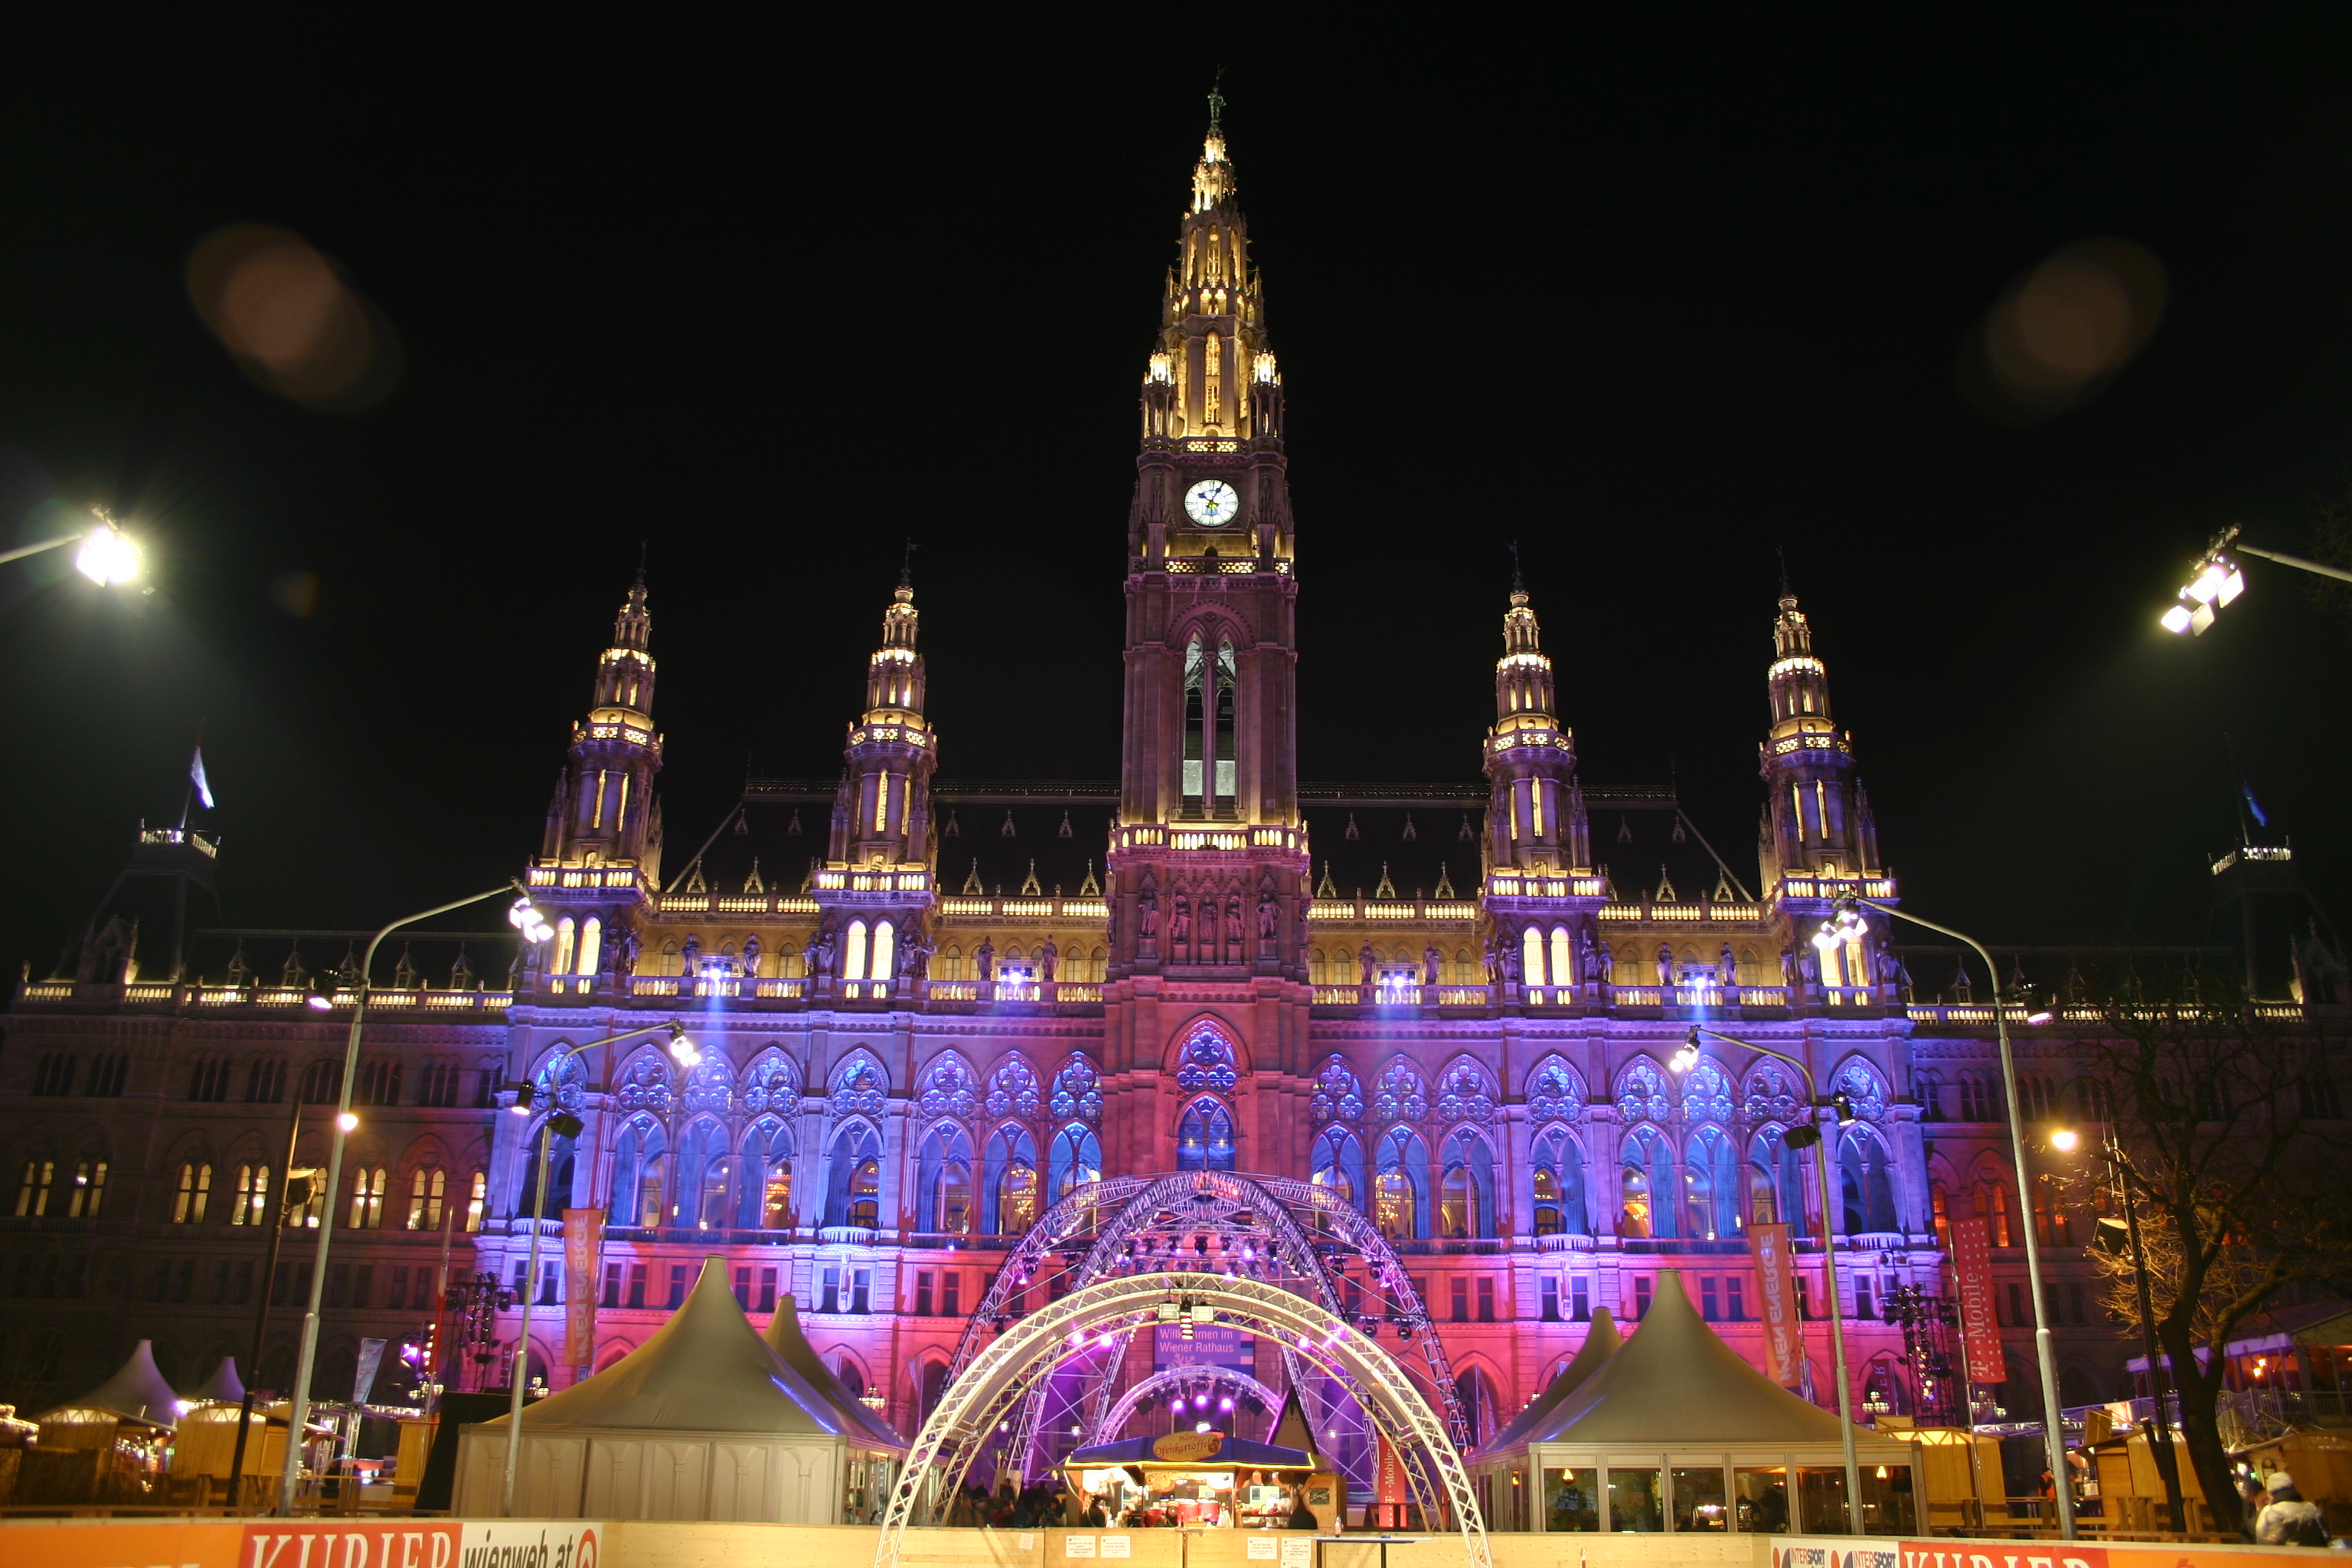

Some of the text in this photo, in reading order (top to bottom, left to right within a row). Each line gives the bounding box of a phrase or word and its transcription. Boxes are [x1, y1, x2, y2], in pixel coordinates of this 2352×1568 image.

[1962, 1272, 1986, 1338] Mobile
[1221, 1330, 1233, 1340] im
[1159, 1341, 1234, 1353] Wiener Rathaus
[1383, 1451, 1395, 1485] Mobile
[1790, 1547, 1826, 1566] INTERSPORT
[1853, 1550, 1896, 1568] INTERSPORT
